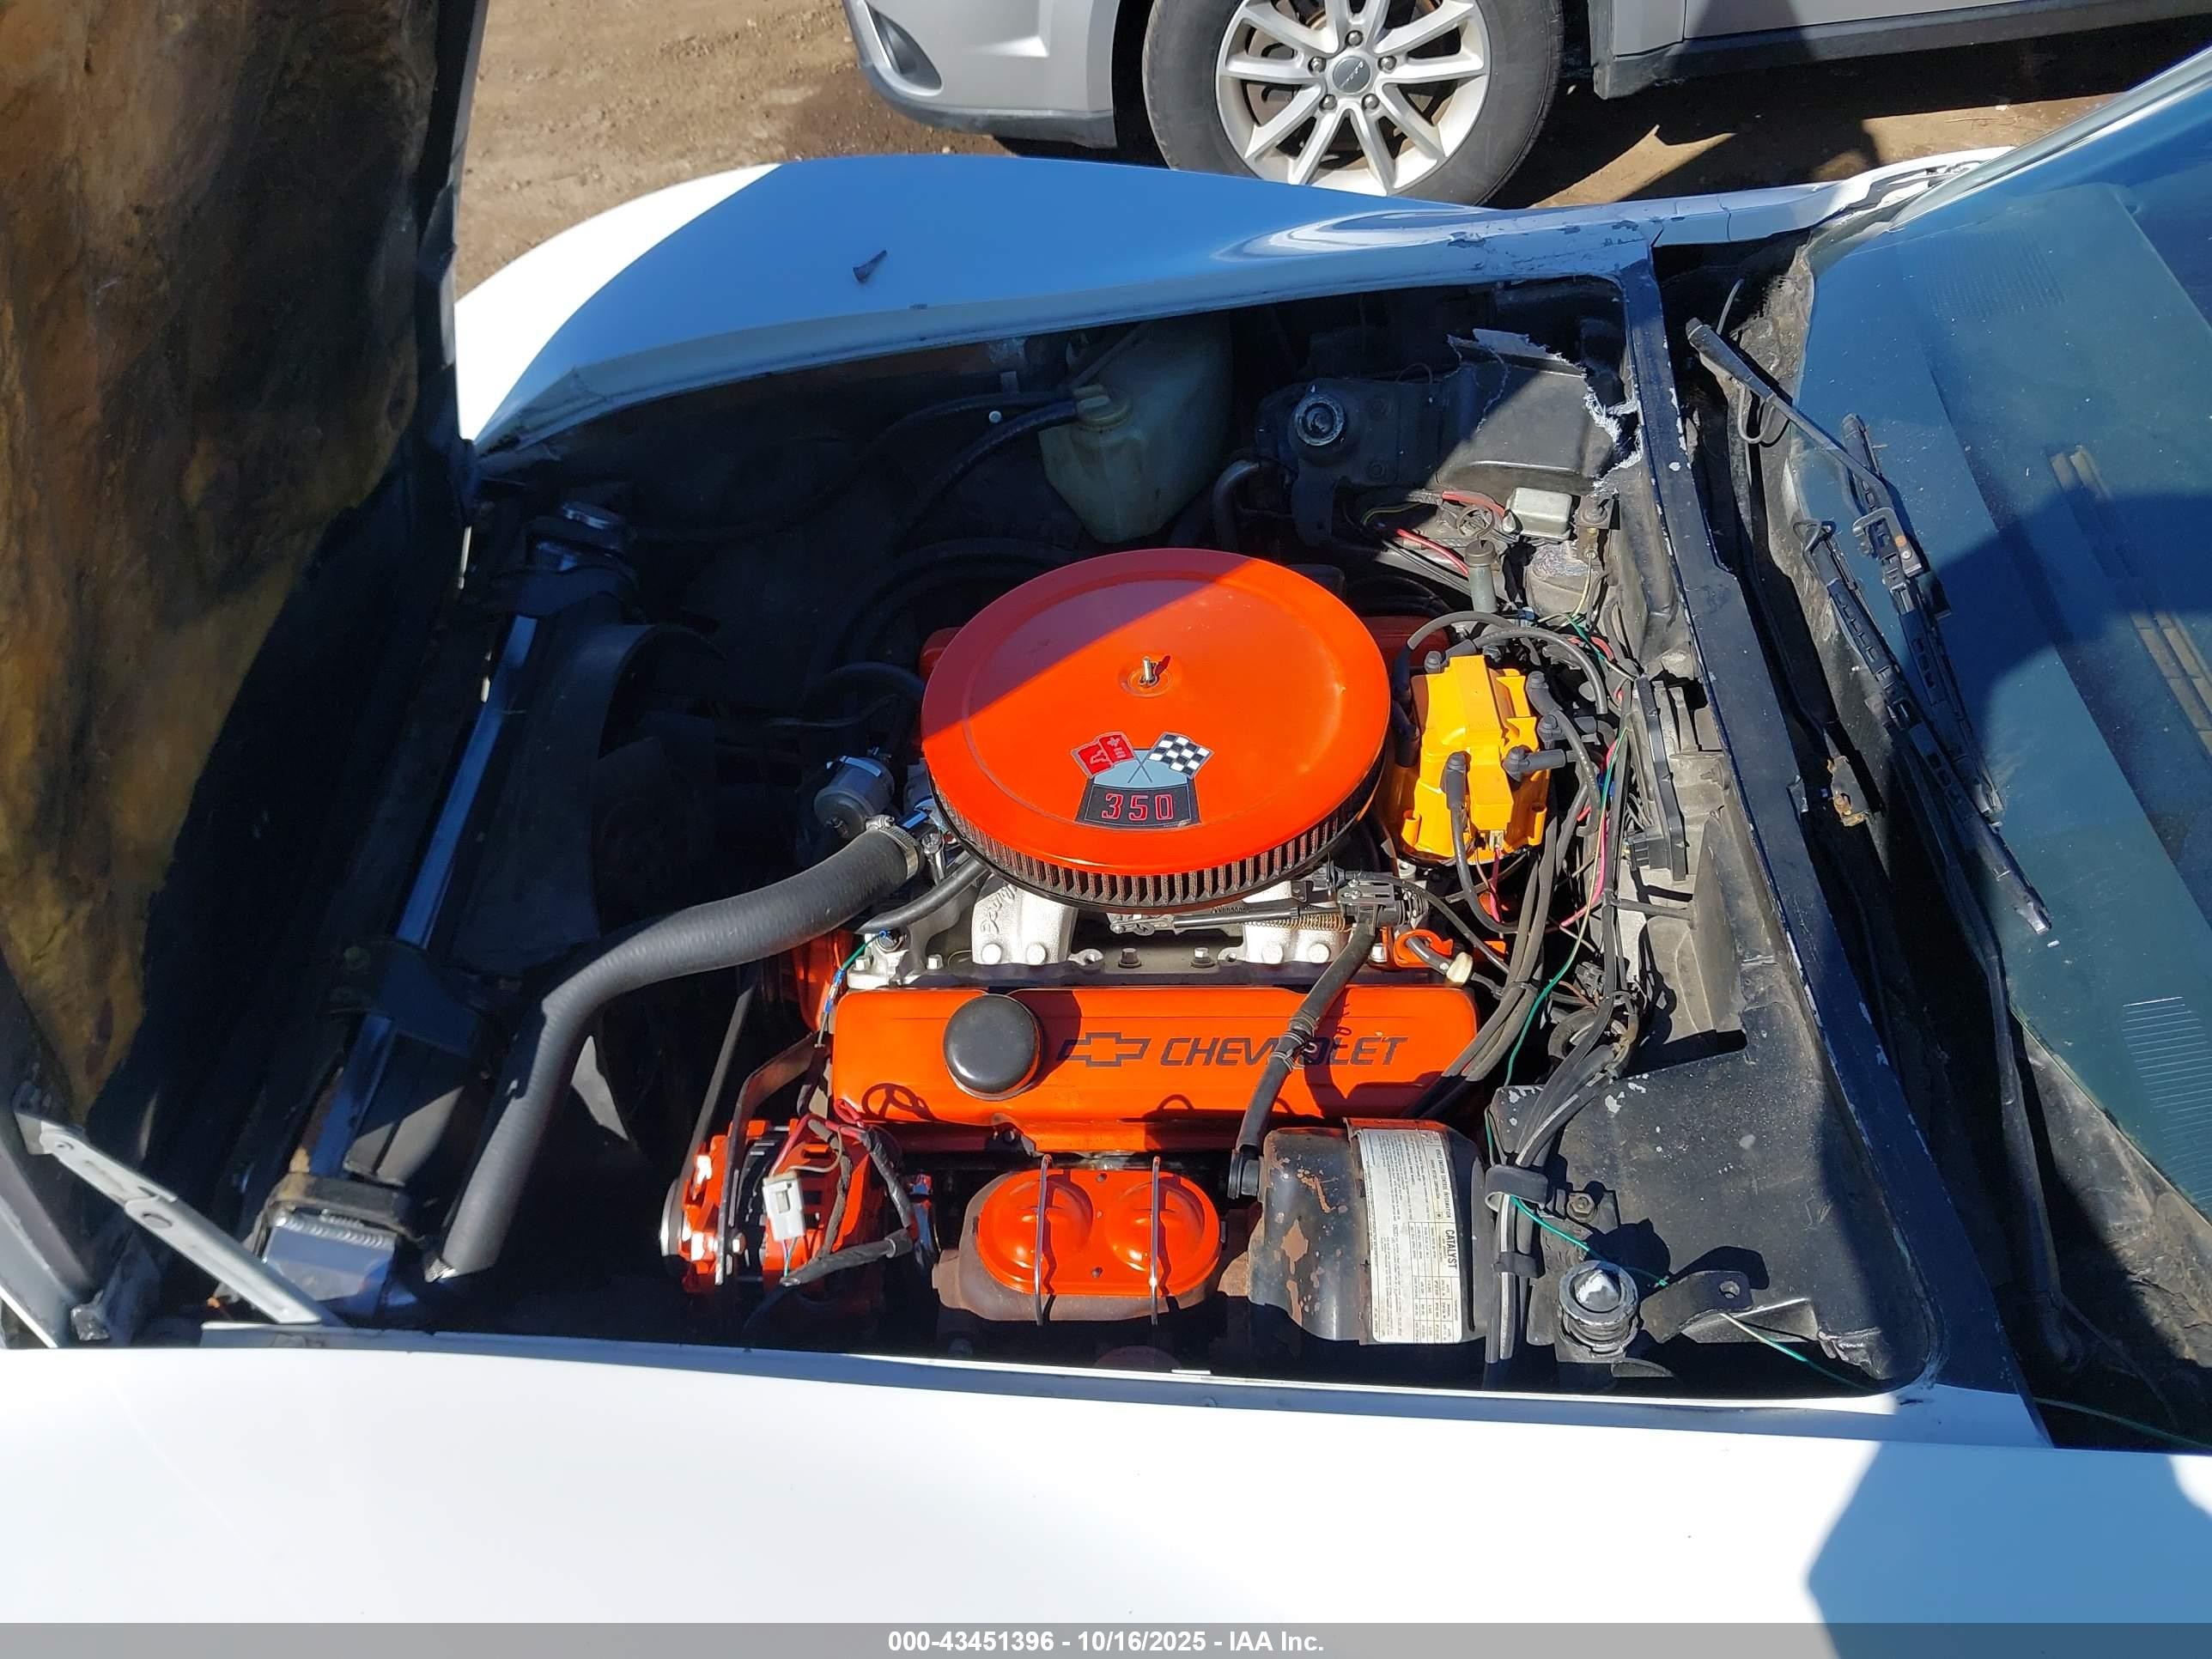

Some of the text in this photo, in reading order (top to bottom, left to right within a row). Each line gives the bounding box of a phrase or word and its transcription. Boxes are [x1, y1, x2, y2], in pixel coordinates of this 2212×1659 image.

[1101, 793, 1175, 821] 350
[1159, 1036, 1408, 1066] CHEVOLET
[1445, 1229, 1458, 1268] CATALYST
